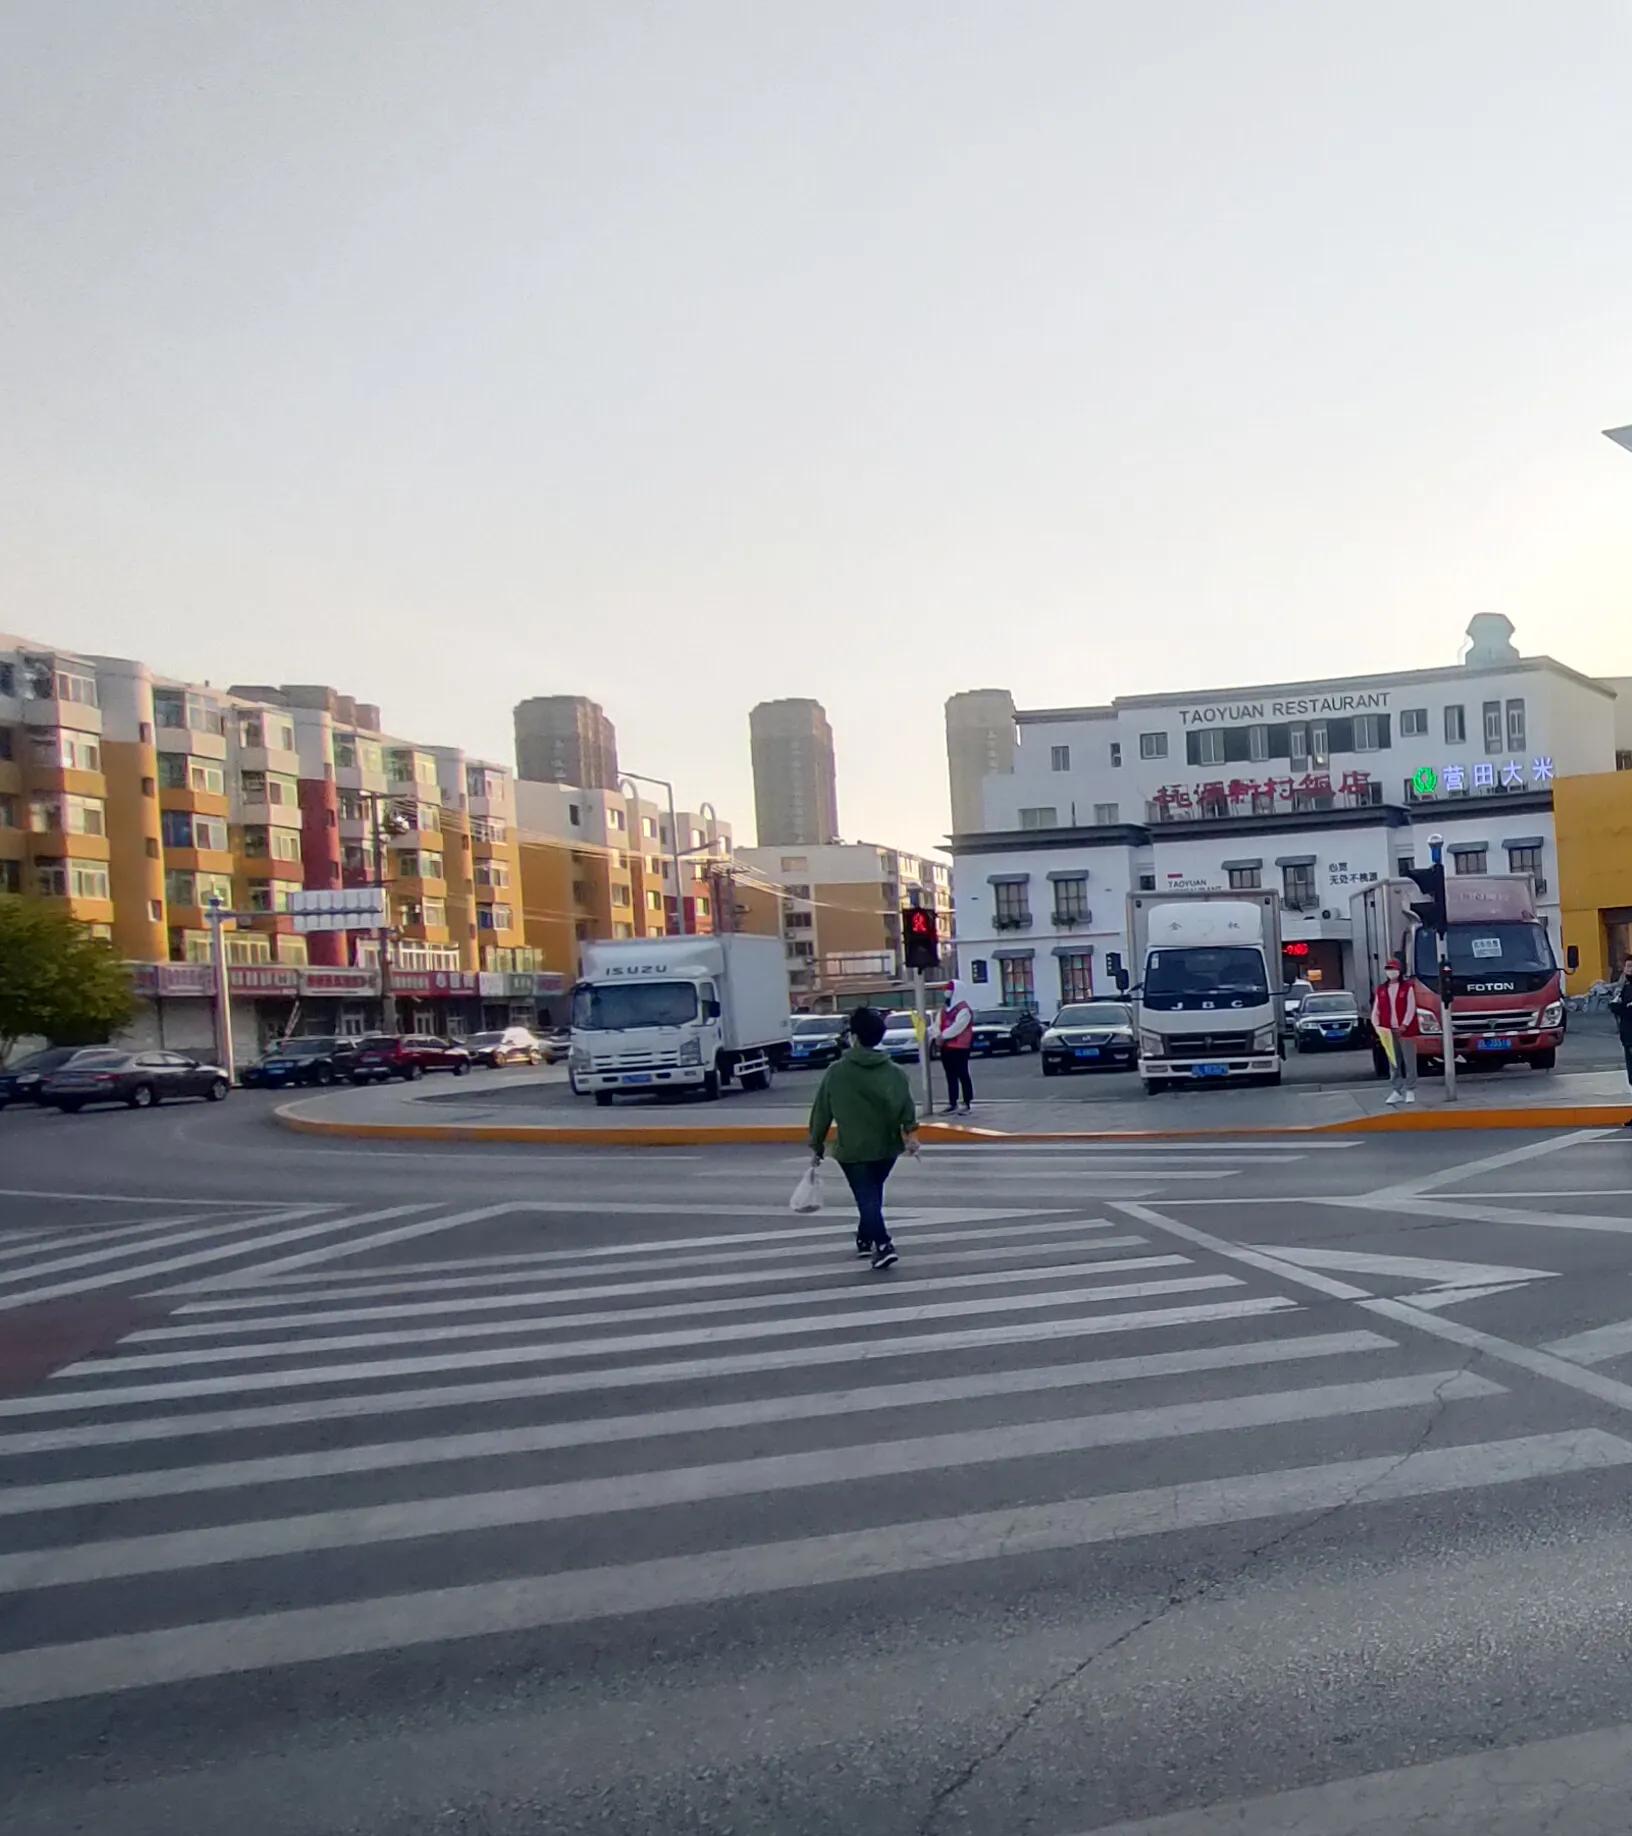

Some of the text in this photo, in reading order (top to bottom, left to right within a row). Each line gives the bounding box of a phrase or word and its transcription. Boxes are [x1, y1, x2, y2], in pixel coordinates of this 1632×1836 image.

[1179, 692, 1391, 726] TAOYUAN RESTAURANT
[1442, 756, 1553, 791] 营田大米
[605, 964, 668, 977] ISUZU
[1466, 982, 1515, 992] FOTON
